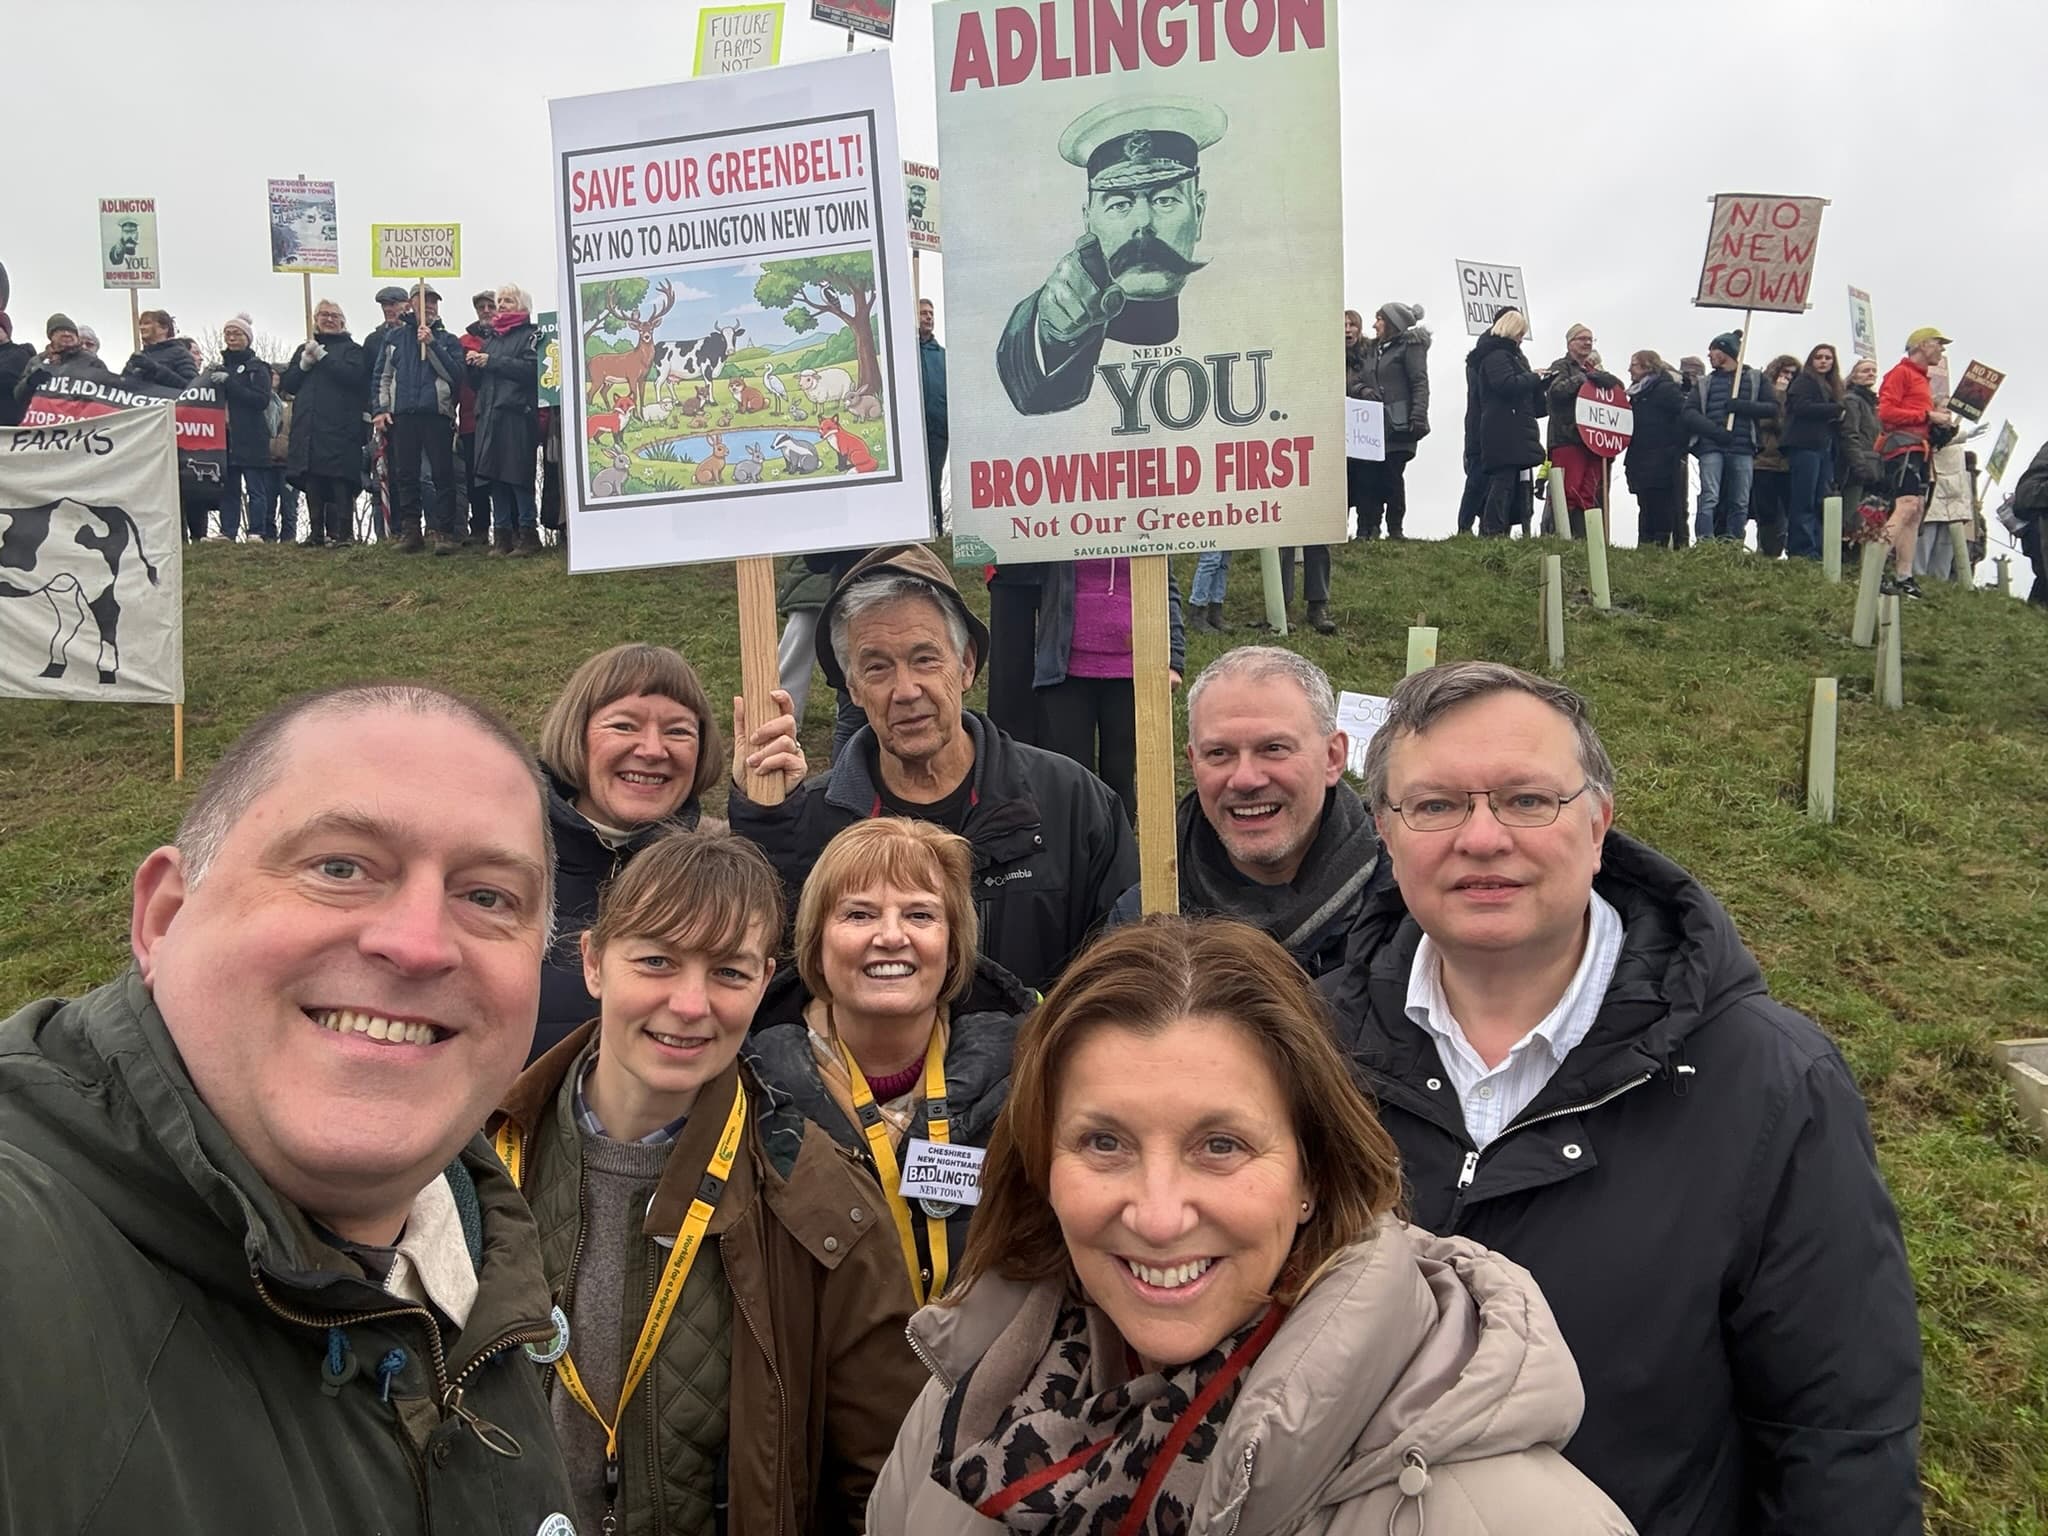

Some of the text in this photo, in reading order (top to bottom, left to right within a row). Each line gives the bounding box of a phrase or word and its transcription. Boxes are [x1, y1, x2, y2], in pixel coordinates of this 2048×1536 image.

[711, 12, 772, 37] FUTURE
[714, 38, 762, 59] FARMS
[950, 0, 1326, 93] ADLINGTON
[721, 57, 754, 73] NOT
[571, 133, 864, 214] SAVE OUR GREENBELT!
[904, 161, 940, 181] LINGTO
[102, 199, 155, 213] ADLINGTON
[1729, 201, 1801, 230] NO
[384, 227, 455, 242] JUST STOP
[571, 199, 870, 265] SAY NO TO ADLINGTON NEW TOWN
[385, 245, 454, 258] ADLINGTON
[1721, 232, 1815, 265] NEW
[390, 257, 451, 268] NEW TOWN
[1463, 267, 1519, 300] SAVE
[1706, 263, 1810, 303] TOWN
[1467, 301, 1524, 324] ADLIN
[1132, 345, 1183, 359] NEEDS
[1595, 387, 1614, 403] NO
[1589, 406, 1620, 427] NEW
[175, 421, 215, 437] OWN
[1585, 428, 1623, 451] TOWN
[10, 428, 115, 456] FARMS
[969, 435, 1315, 510] BROWNFIELD FIRST
[1010, 500, 1283, 540] Not Our Greenbelt
[1073, 538, 1217, 557] SAVEADLINGTON.CO.UK
[917, 1155, 936, 1164] NEW
[928, 1147, 972, 1159] CHESHIRES
[908, 1166, 977, 1188] BADLINGTO
[919, 1184, 965, 1199] NEW TOWN
[674, 1234, 694, 1269] Working
[671, 1268, 680, 1281] for
[654, 1288, 673, 1321] brighter
